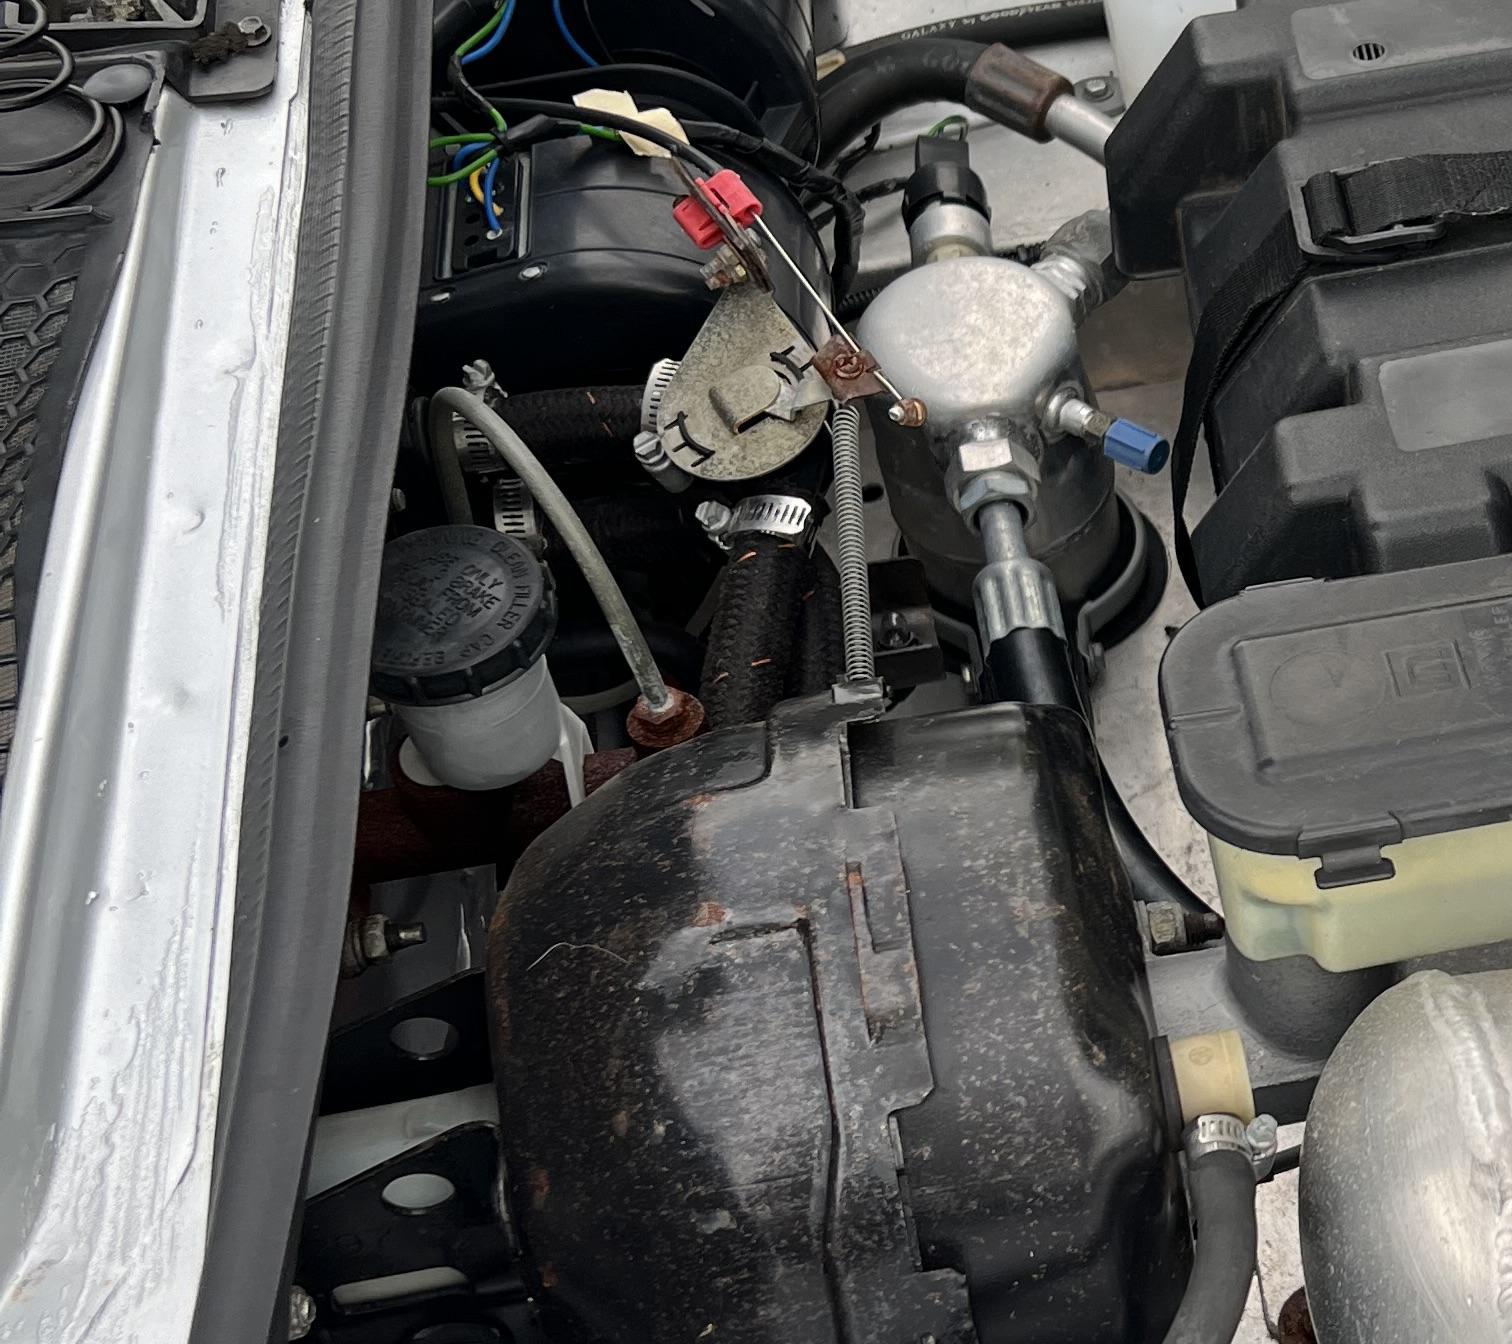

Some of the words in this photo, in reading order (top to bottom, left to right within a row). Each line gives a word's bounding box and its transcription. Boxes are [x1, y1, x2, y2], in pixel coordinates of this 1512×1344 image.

[900, 19, 959, 41] GALAXY
[489, 540, 529, 579] CLEAN
[460, 564, 504, 590] ONLY
[496, 584, 531, 630] FILLER
